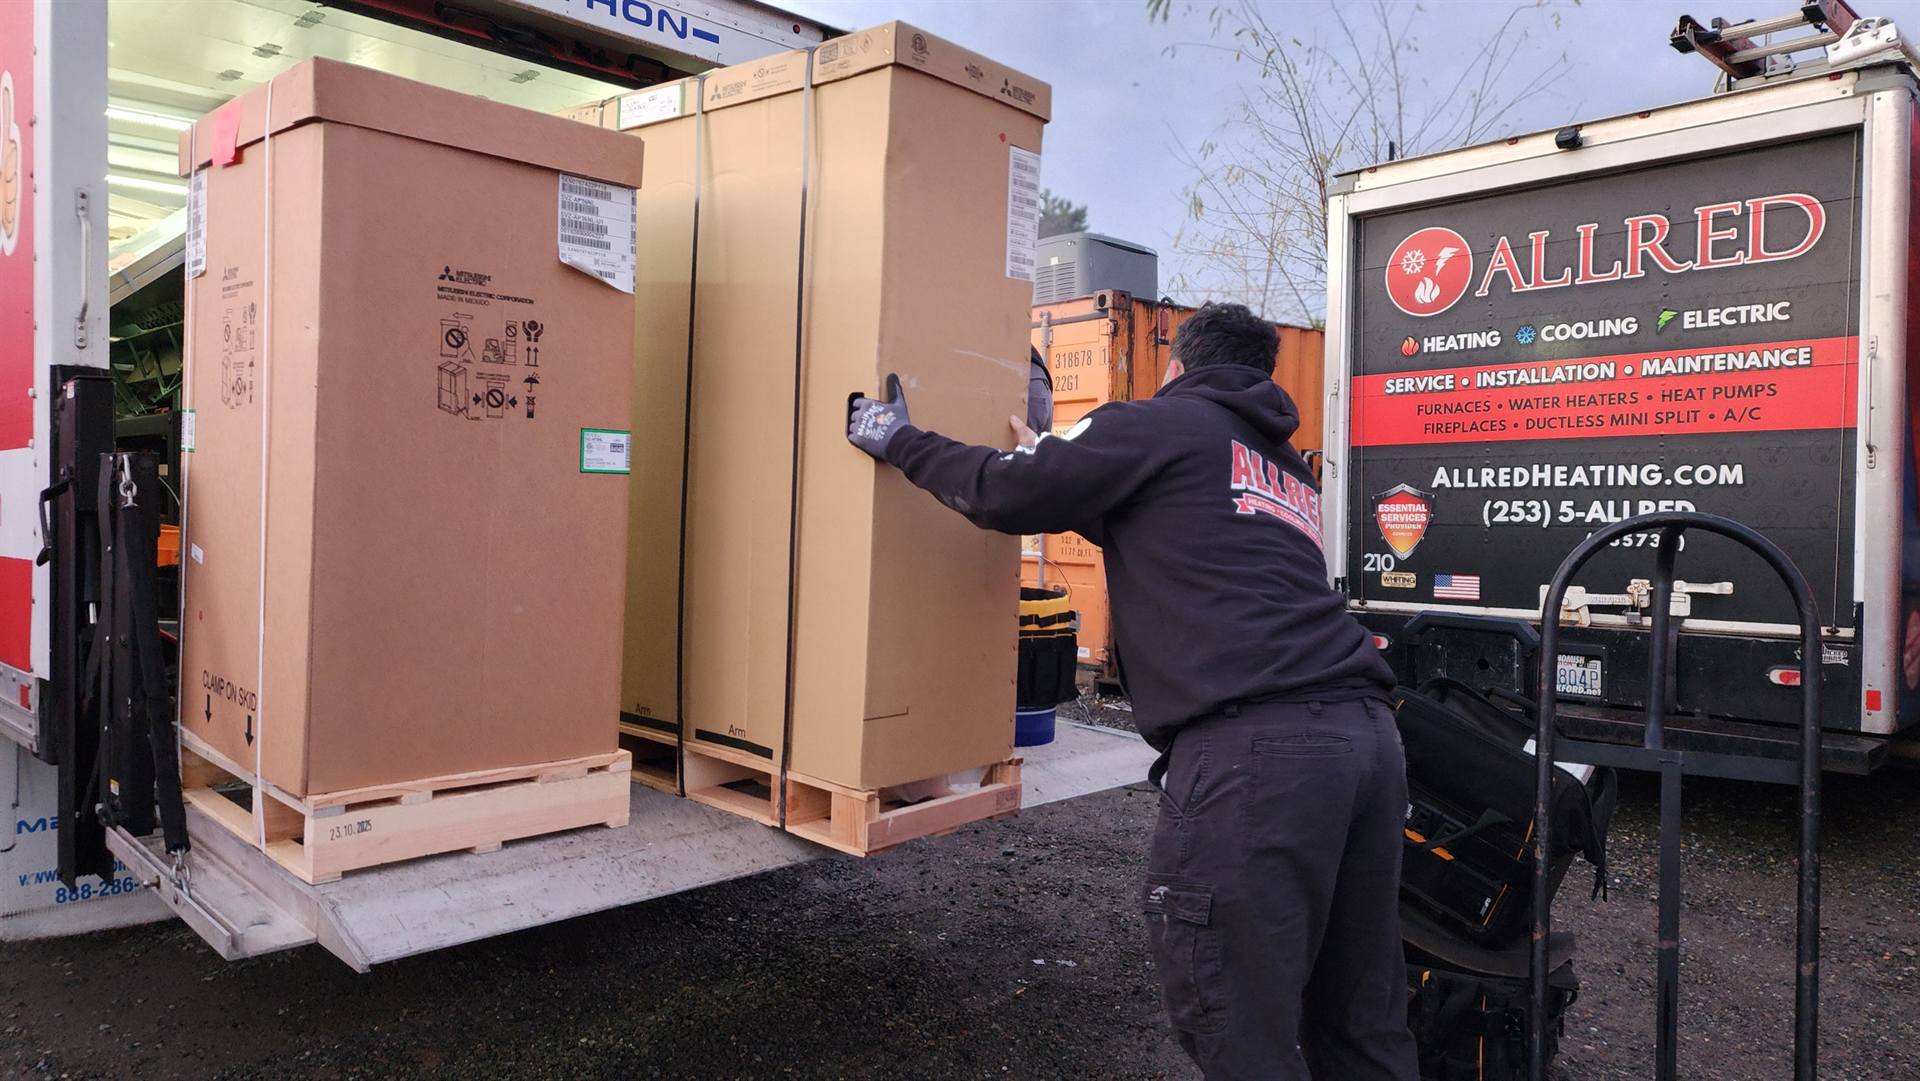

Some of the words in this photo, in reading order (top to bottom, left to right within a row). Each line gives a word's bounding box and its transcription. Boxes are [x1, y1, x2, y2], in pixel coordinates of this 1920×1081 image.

[1475, 193, 1827, 297] ALLRED
[456, 270, 492, 282] MITSUBISHI
[456, 276, 487, 287] ELECTRIC
[437, 293, 457, 302] MADE
[465, 297, 491, 306] MEXICO
[469, 291, 496, 300] ELECTRIC
[496, 294, 535, 305] CORPORATION
[1423, 331, 1501, 353] HEATING
[1541, 316, 1639, 342] COOLING
[1683, 301, 1791, 329] ELECTRIC
[1055, 350, 1093, 369] 318678
[1384, 374, 1454, 394] SERVICE
[1476, 362, 1616, 388] INSTALLATION
[1641, 346, 1812, 377] MAINTENANCE
[1055, 374, 1079, 392] 22G1
[1416, 400, 1491, 416] FURNACES
[1508, 396, 1561, 411] WATER
[1566, 391, 1639, 408] HEATERS
[1661, 387, 1706, 403] HEAT
[1712, 383, 1777, 400] PUMPS
[1423, 419, 1507, 435] FIREPLACES
[1525, 414, 1605, 431] DUCTLESS
[1610, 412, 1648, 427] MINI
[1654, 409, 1701, 425] SPLIT
[1723, 406, 1761, 423] A/C
[1230, 439, 1324, 532] ALLRE
[1378, 503, 1428, 513] ESSENTIAL
[1483, 499, 1551, 528] (253)
[1381, 513, 1427, 523] SERVICES
[1363, 553, 1395, 572] 210
[1382, 574, 1416, 584] WHITING
[202, 669, 225, 696] CLAMP
[225, 681, 237, 703] ON
[238, 686, 257, 712] SKID
[635, 703, 652, 716] Arm
[728, 724, 746, 738] Arm
